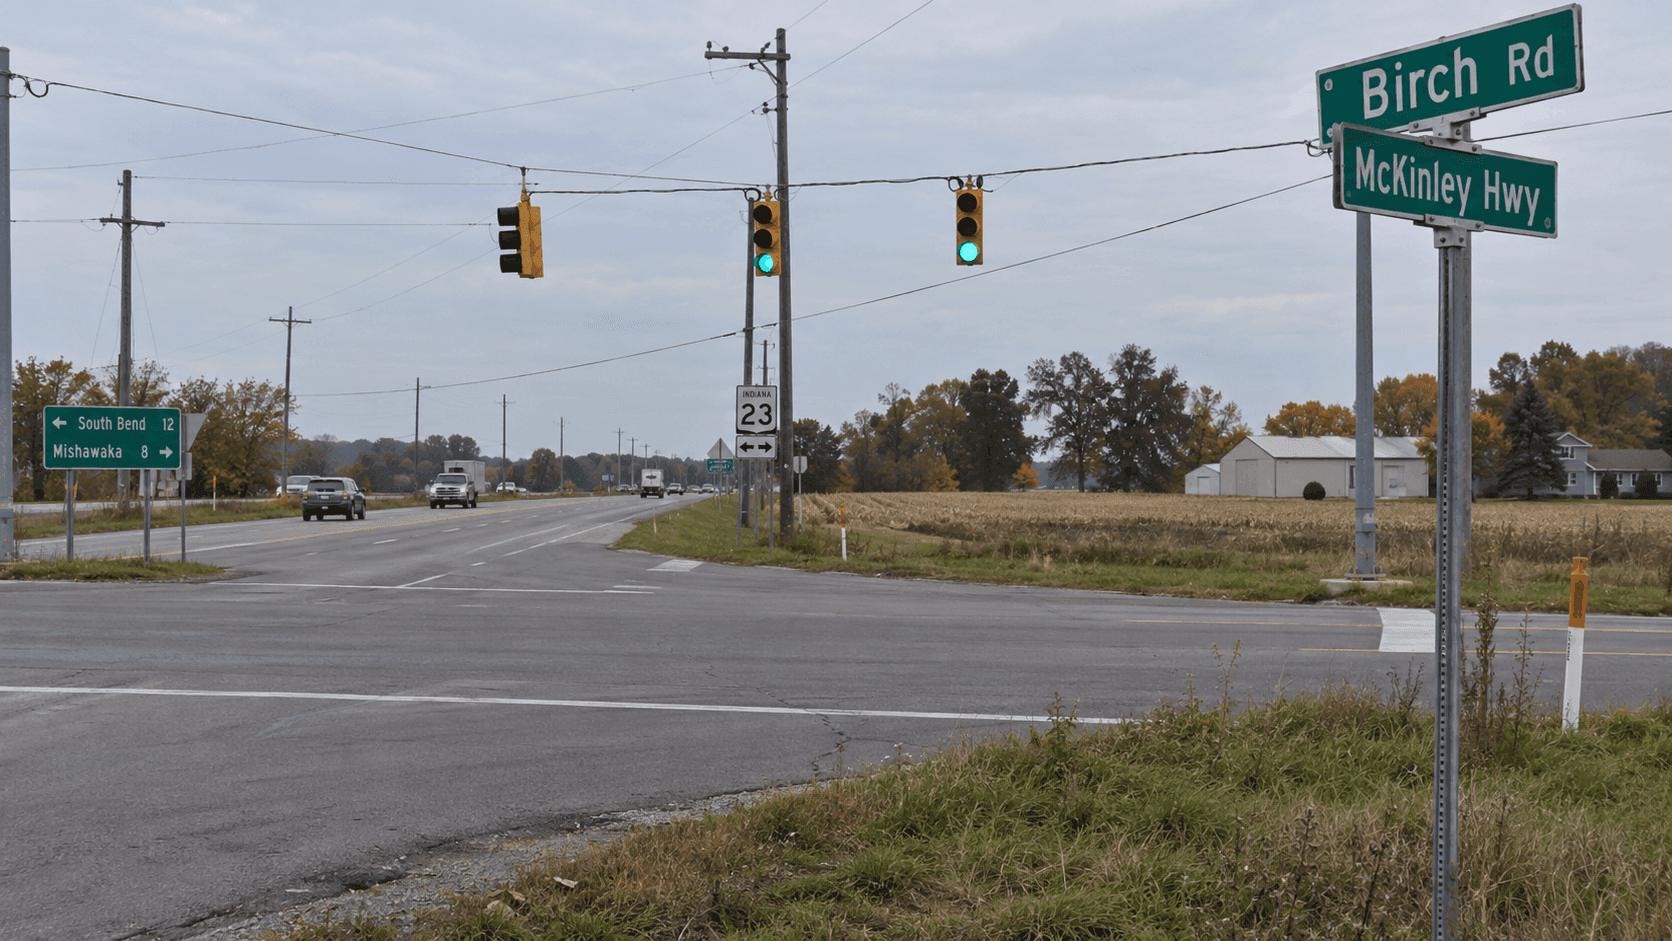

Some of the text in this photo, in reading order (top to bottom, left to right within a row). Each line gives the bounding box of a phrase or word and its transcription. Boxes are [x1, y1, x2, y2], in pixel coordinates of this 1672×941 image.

[1362, 34, 1554, 119] Birch Rd
[1355, 146, 1540, 227] McKinley Hwy
[742, 390, 772, 398] INDIANA
[741, 403, 772, 425] 23
[78, 416, 175, 431] South Bend 12
[53, 444, 149, 459] Mishawaka 8
